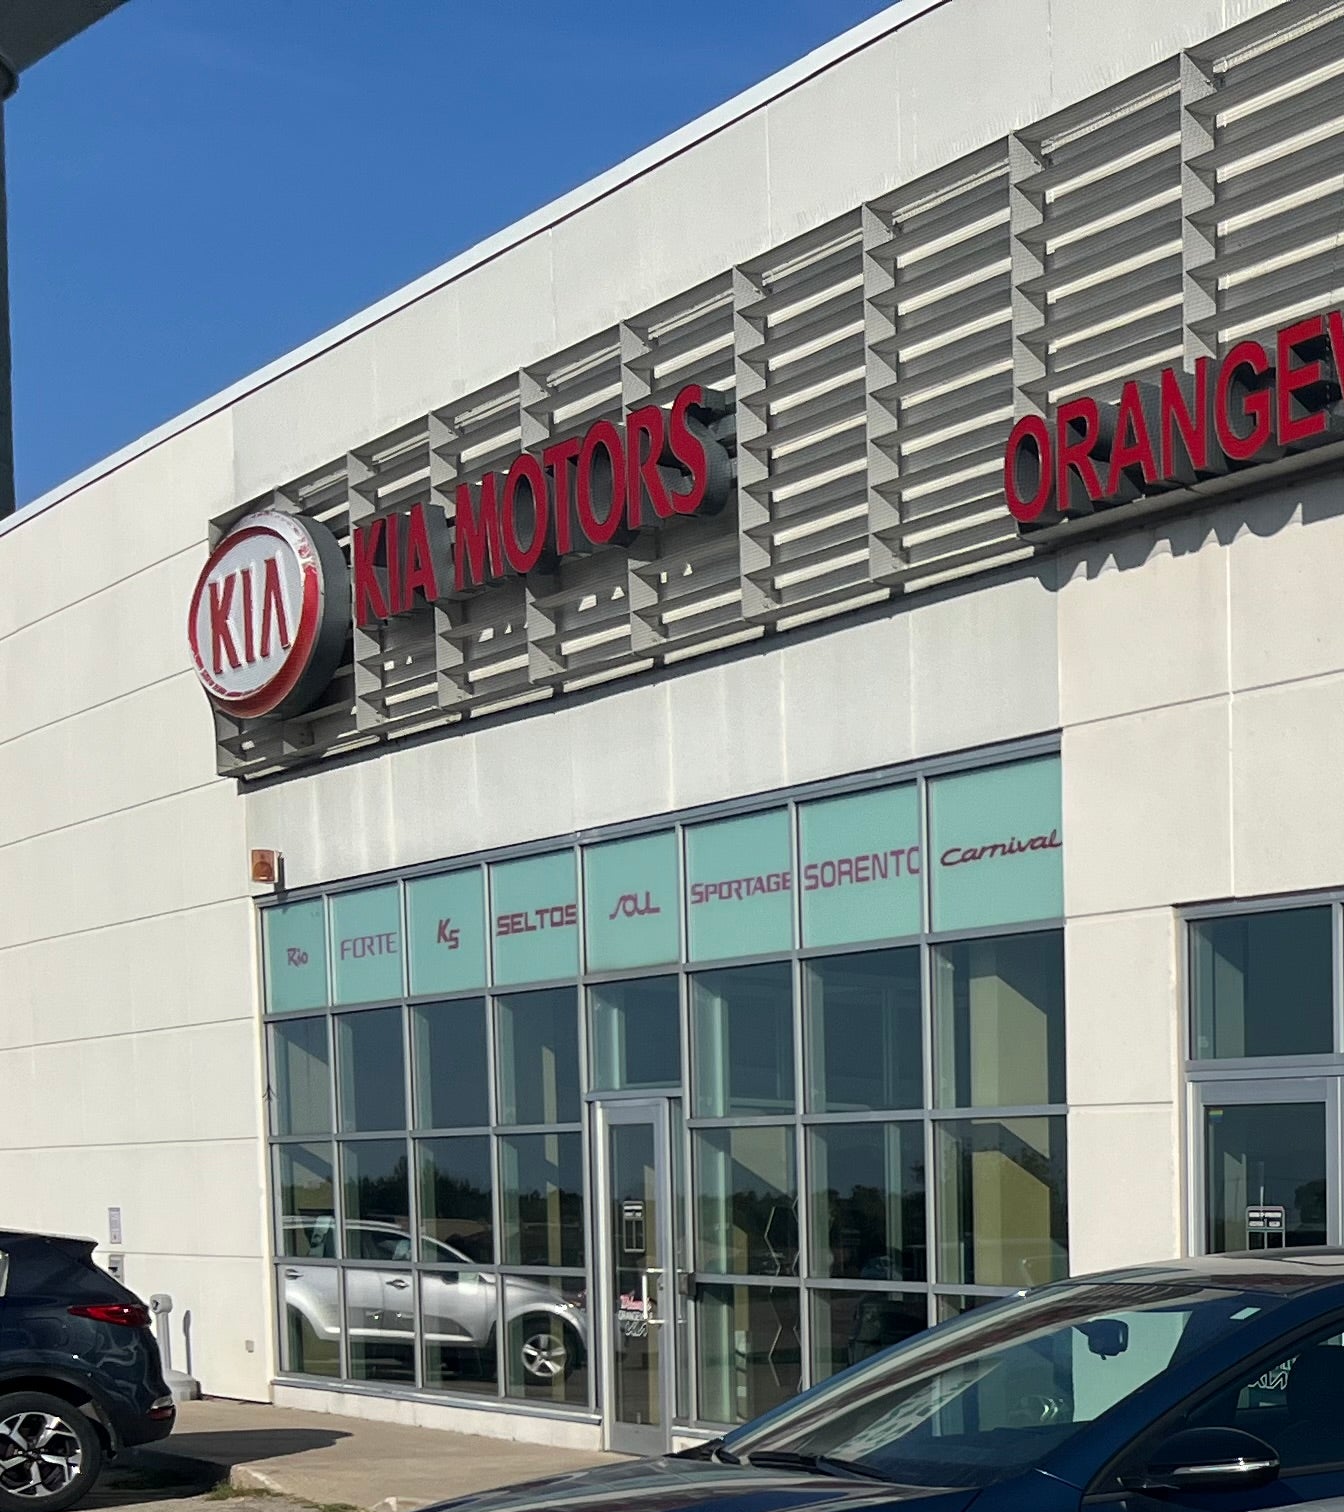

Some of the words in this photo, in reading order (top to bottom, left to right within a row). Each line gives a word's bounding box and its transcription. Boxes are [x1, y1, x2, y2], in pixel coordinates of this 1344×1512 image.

[354, 502, 440, 627] KIA
[454, 384, 708, 592] MOTORS
[207, 555, 293, 675] KIA
[940, 829, 1062, 867] Carnival
[690, 871, 791, 905] SPORTAGE
[496, 904, 577, 936] SELTOS
[340, 931, 398, 961] FORTE
